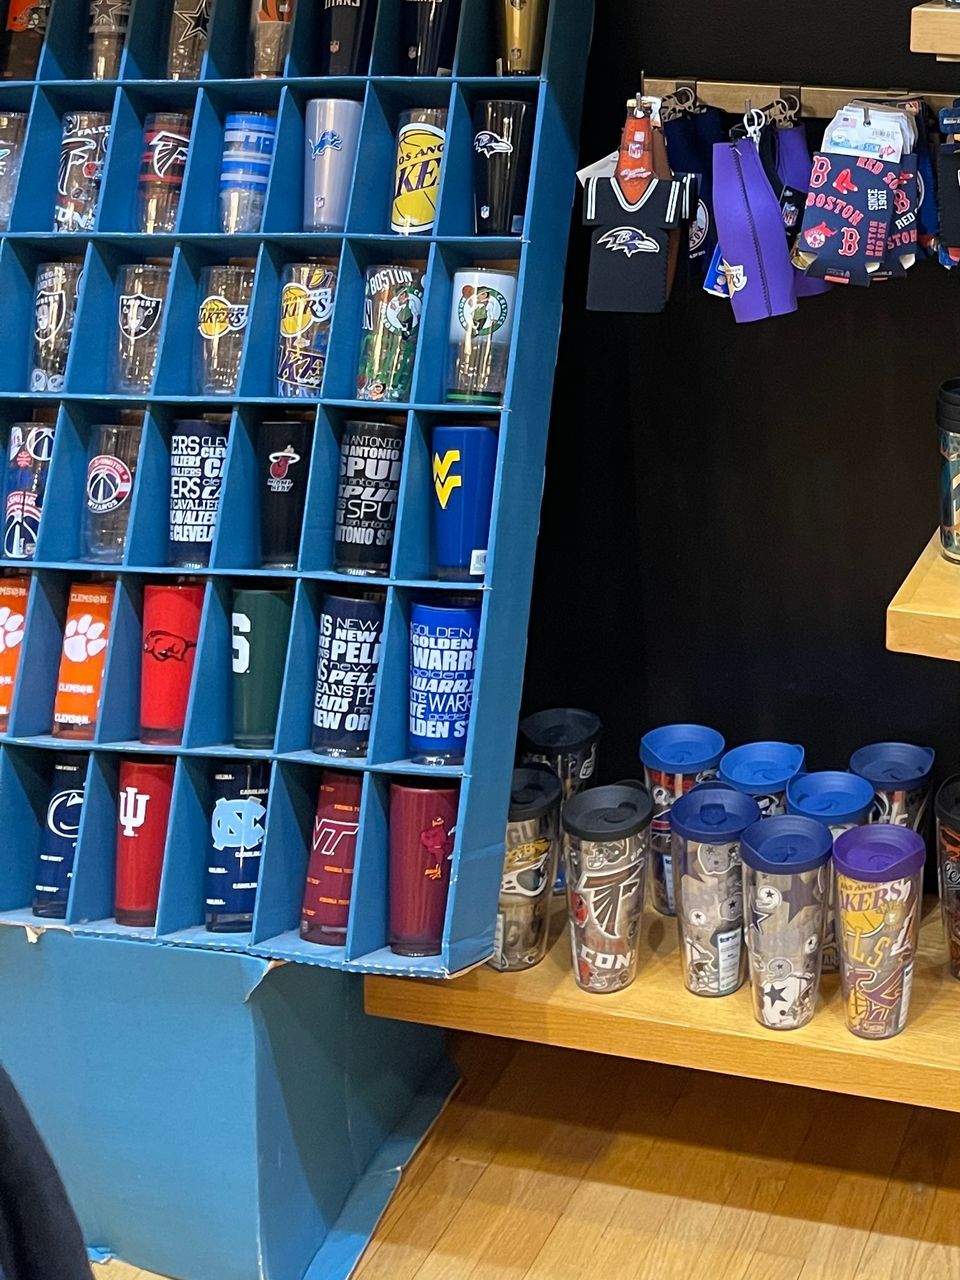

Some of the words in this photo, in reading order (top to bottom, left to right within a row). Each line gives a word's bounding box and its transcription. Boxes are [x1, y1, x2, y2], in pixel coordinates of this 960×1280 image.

[399, 153, 411, 166] OS
[810, 155, 831, 188] B
[856, 157, 884, 174] RED
[882, 172, 900, 189] SO
[867, 188, 878, 211] SINCE
[878, 189, 887, 210] 1901
[806, 192, 864, 226] BOSTON
[895, 212, 916, 229] RED
[877, 221, 887, 238] SOX
[838, 227, 860, 256] B
[866, 221, 877, 256] BOSTON
[875, 239, 884, 257] RED
[369, 270, 413, 296] BOSTON
[351, 435, 402, 449] ANTONIO
[350, 445, 399, 460] ANTONIO
[346, 499, 395, 521] SPU
[71, 593, 108, 604] CLEMSON
[336, 617, 379, 631] NEW
[412, 623, 472, 638] GOLDEN
[335, 628, 377, 642] NEW
[412, 634, 473, 650] GOLDEN
[330, 661, 371, 672] new
[413, 669, 467, 679] golden
[59, 683, 95, 694] CLEMSON
[55, 714, 90, 725] CLEMSON
